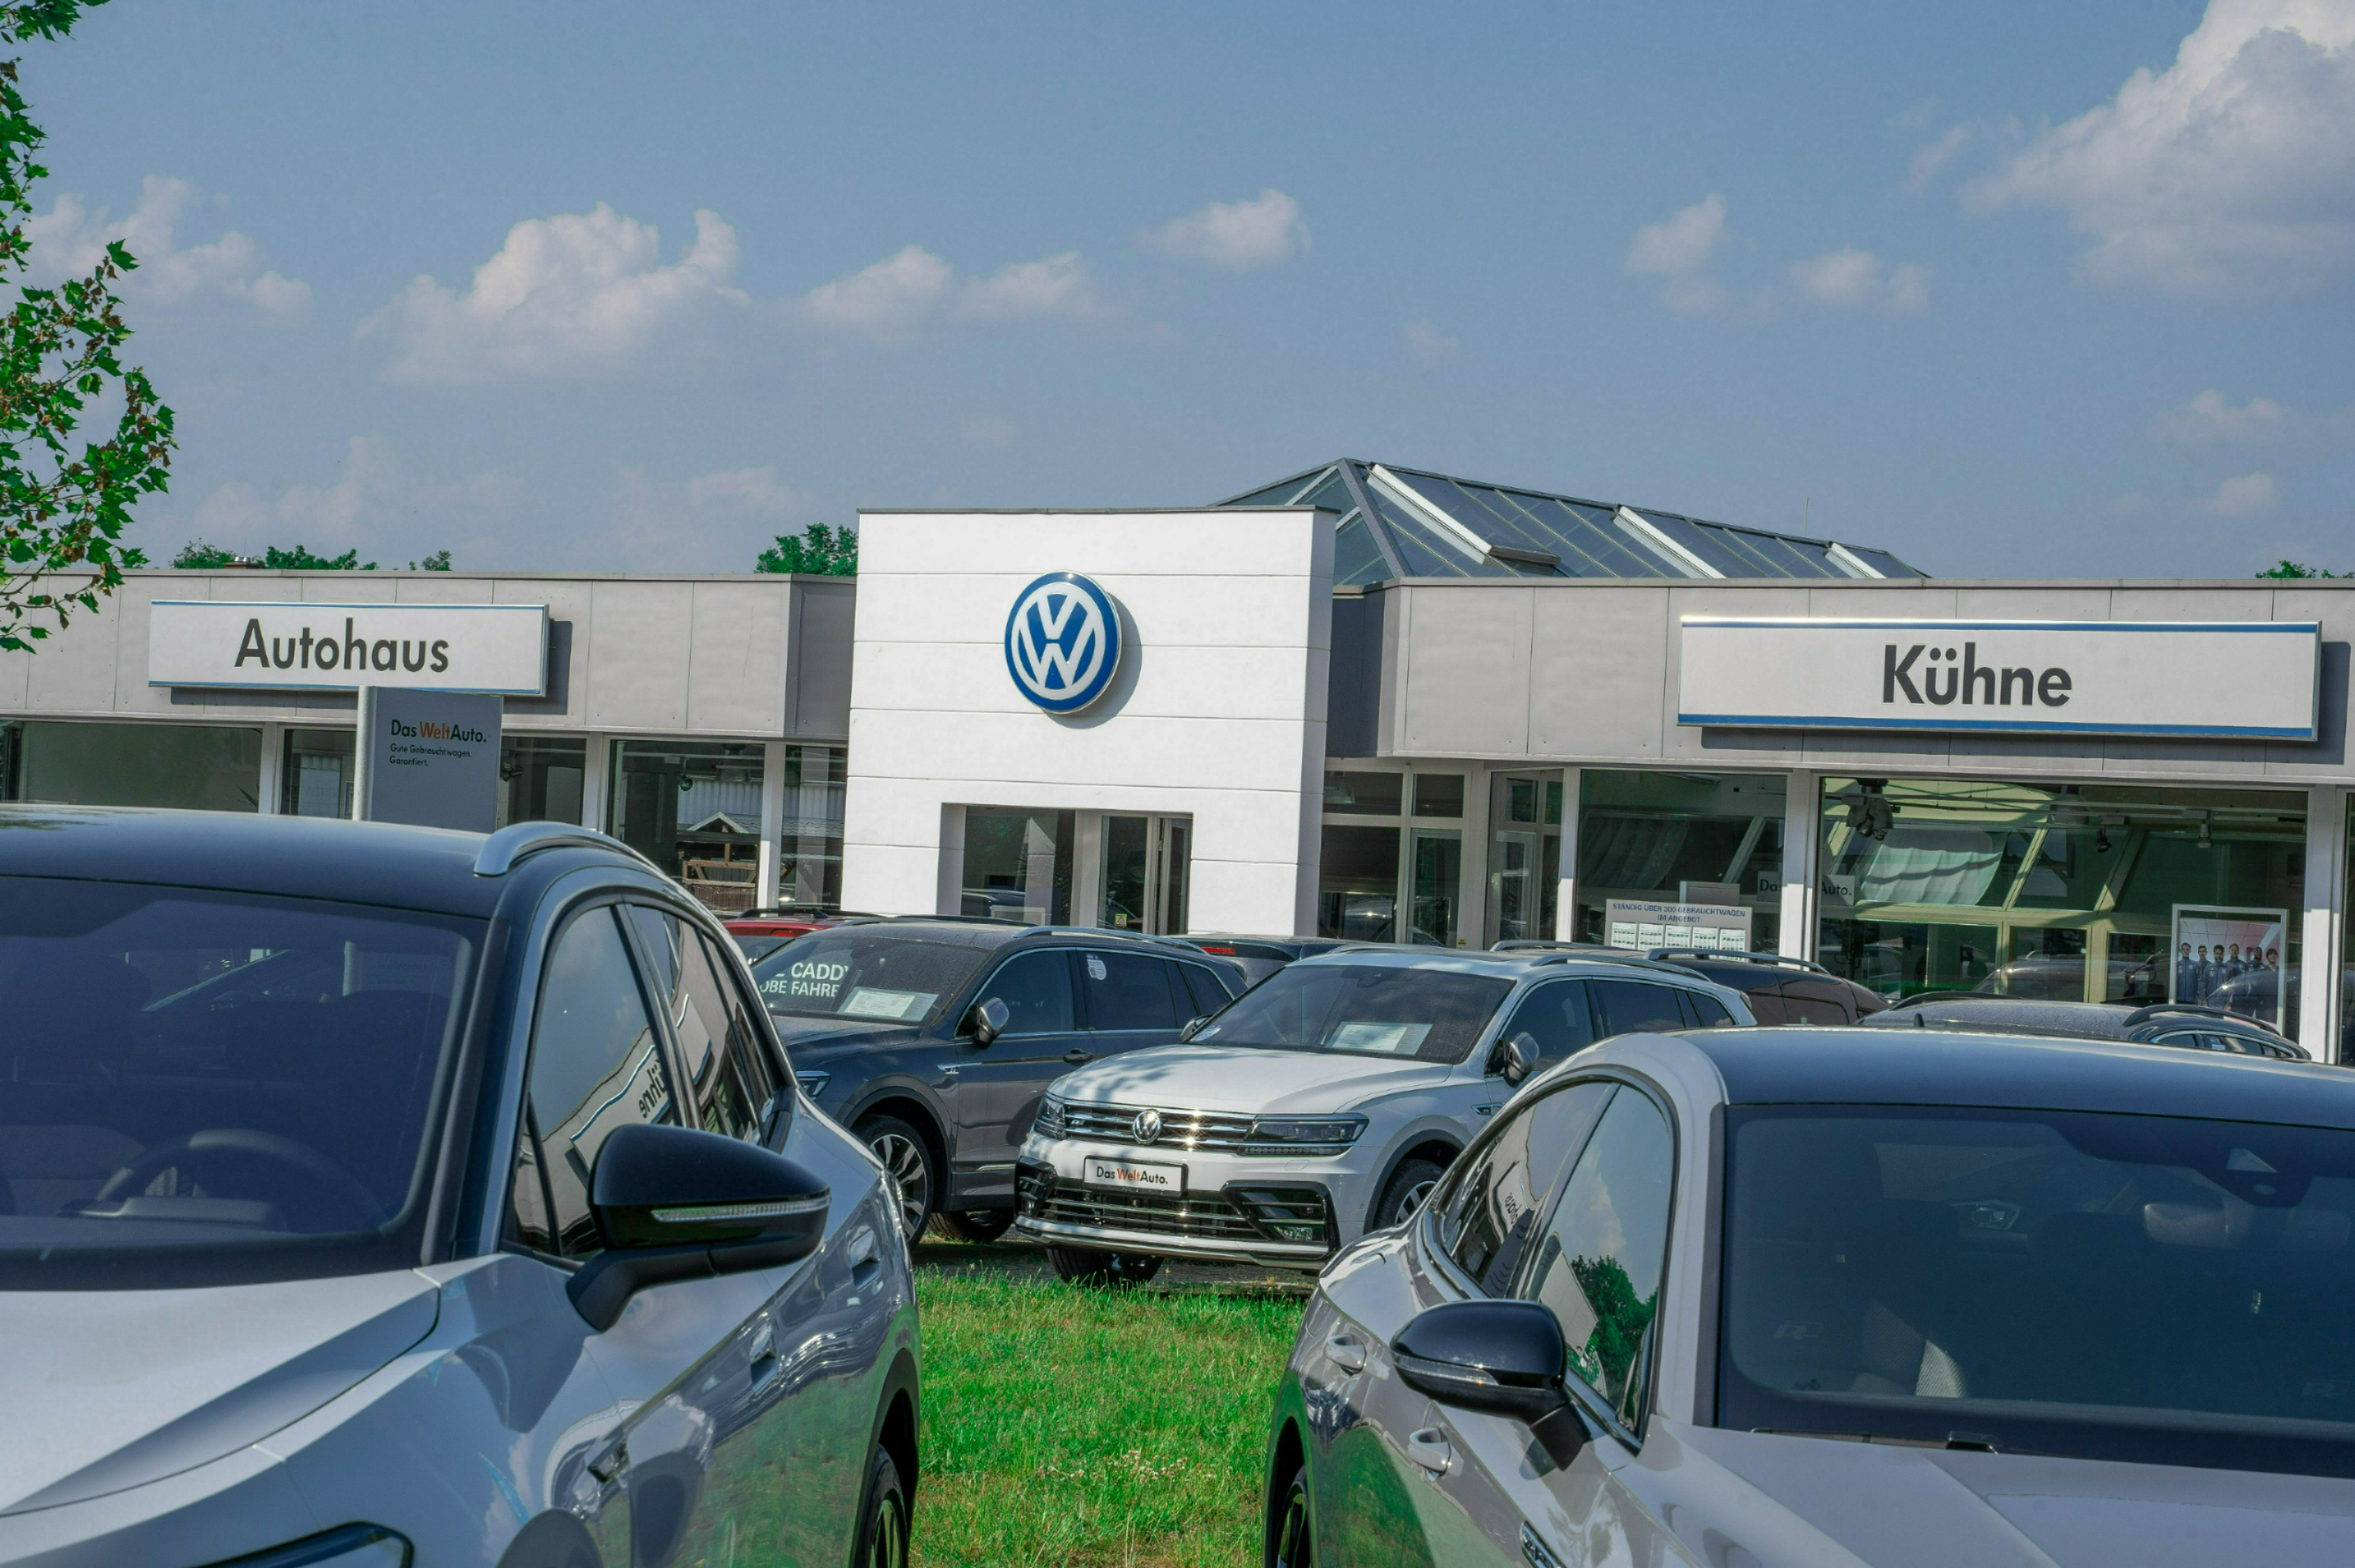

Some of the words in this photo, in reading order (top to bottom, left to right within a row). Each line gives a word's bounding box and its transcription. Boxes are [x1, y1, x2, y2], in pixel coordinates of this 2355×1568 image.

[233, 617, 449, 673] Autohaus
[1882, 641, 2072, 707] Kühne
[390, 719, 418, 737] Das
[419, 721, 487, 743] WeltAuto.
[389, 743, 408, 753] Gute
[389, 755, 429, 766] Garantiert.
[1668, 914, 1700, 923] ANGEBOT
[1677, 906, 1745, 917] GEBRAUCHTWAGEN
[1096, 1166, 1115, 1179] Das
[1116, 1168, 1168, 1185] WeltAuto.
